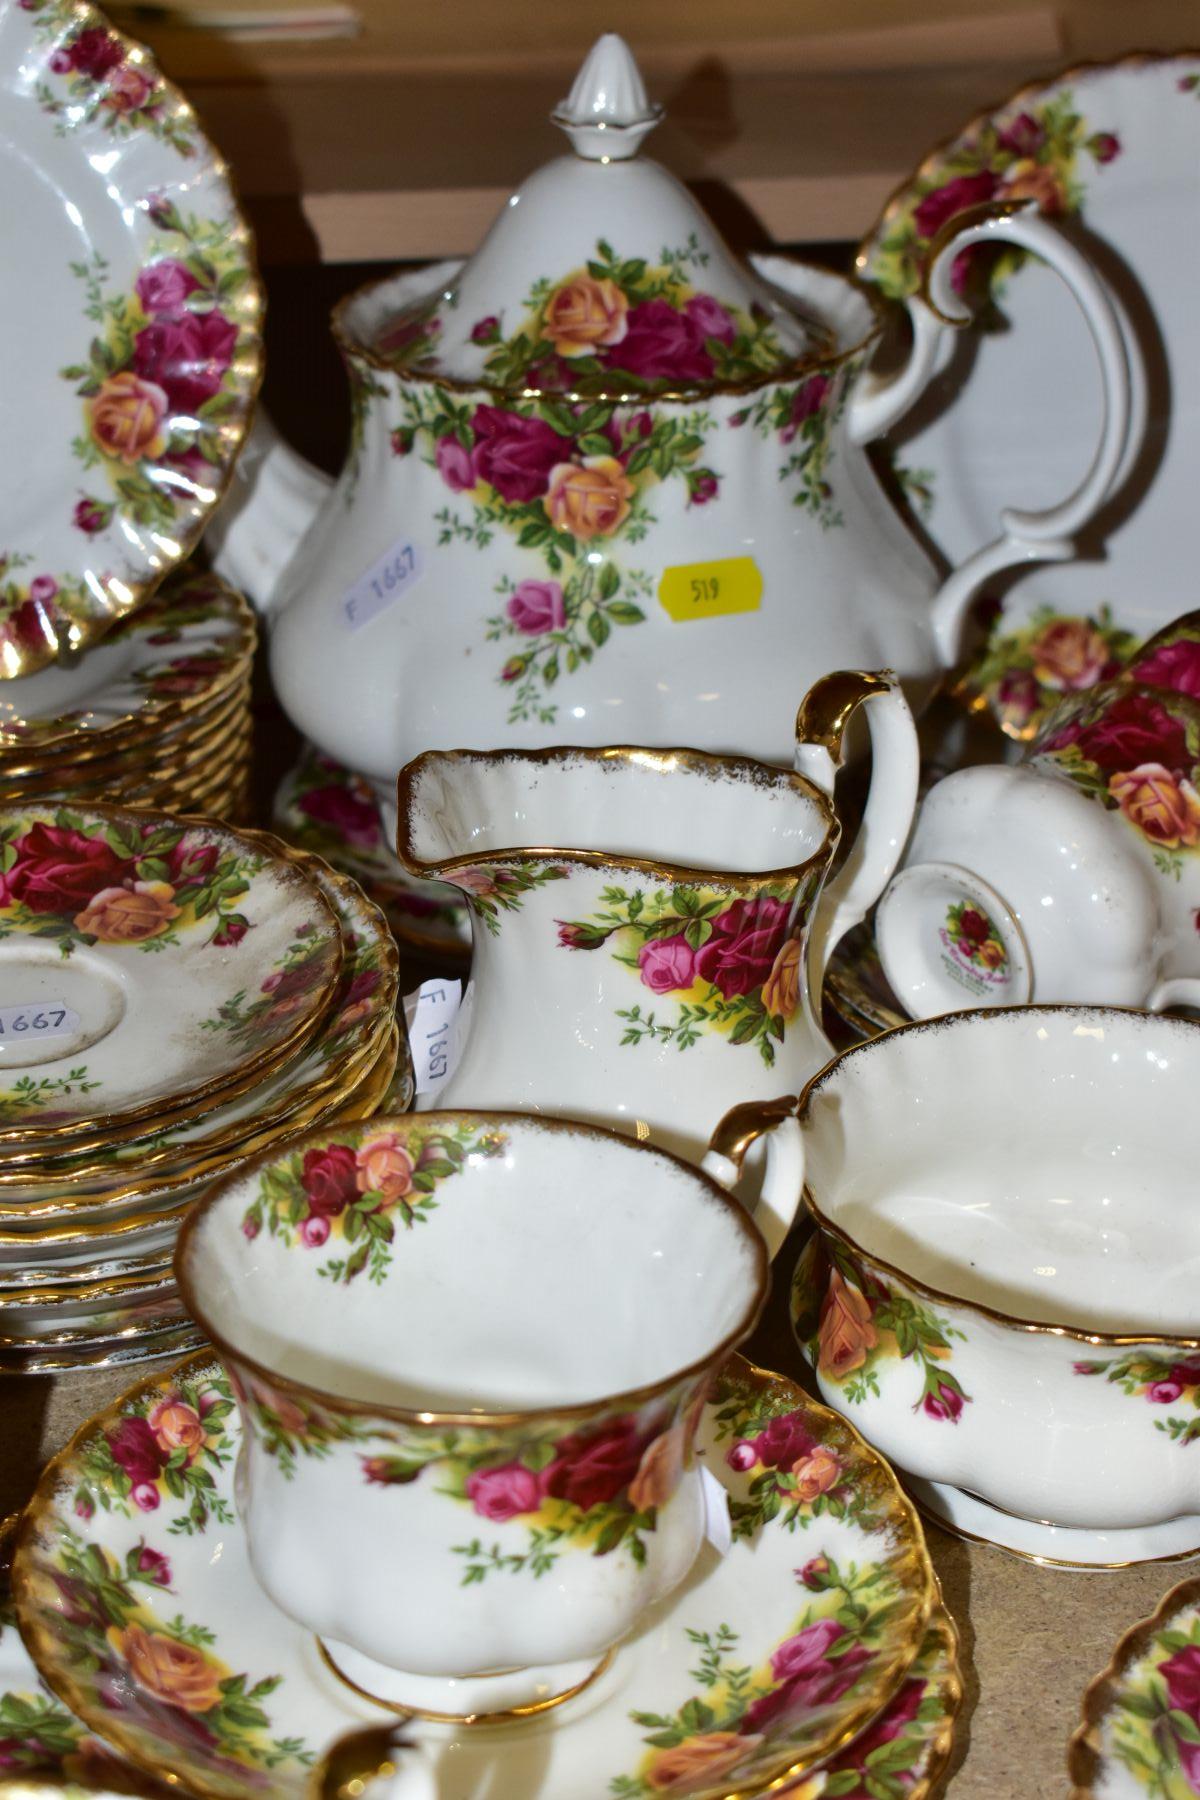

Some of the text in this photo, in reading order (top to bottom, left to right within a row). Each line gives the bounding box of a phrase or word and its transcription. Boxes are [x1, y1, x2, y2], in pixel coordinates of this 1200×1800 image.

[345, 545, 414, 621] F 1667
[691, 577, 719, 602] 519
[420, 988, 449, 1079] F 1667
